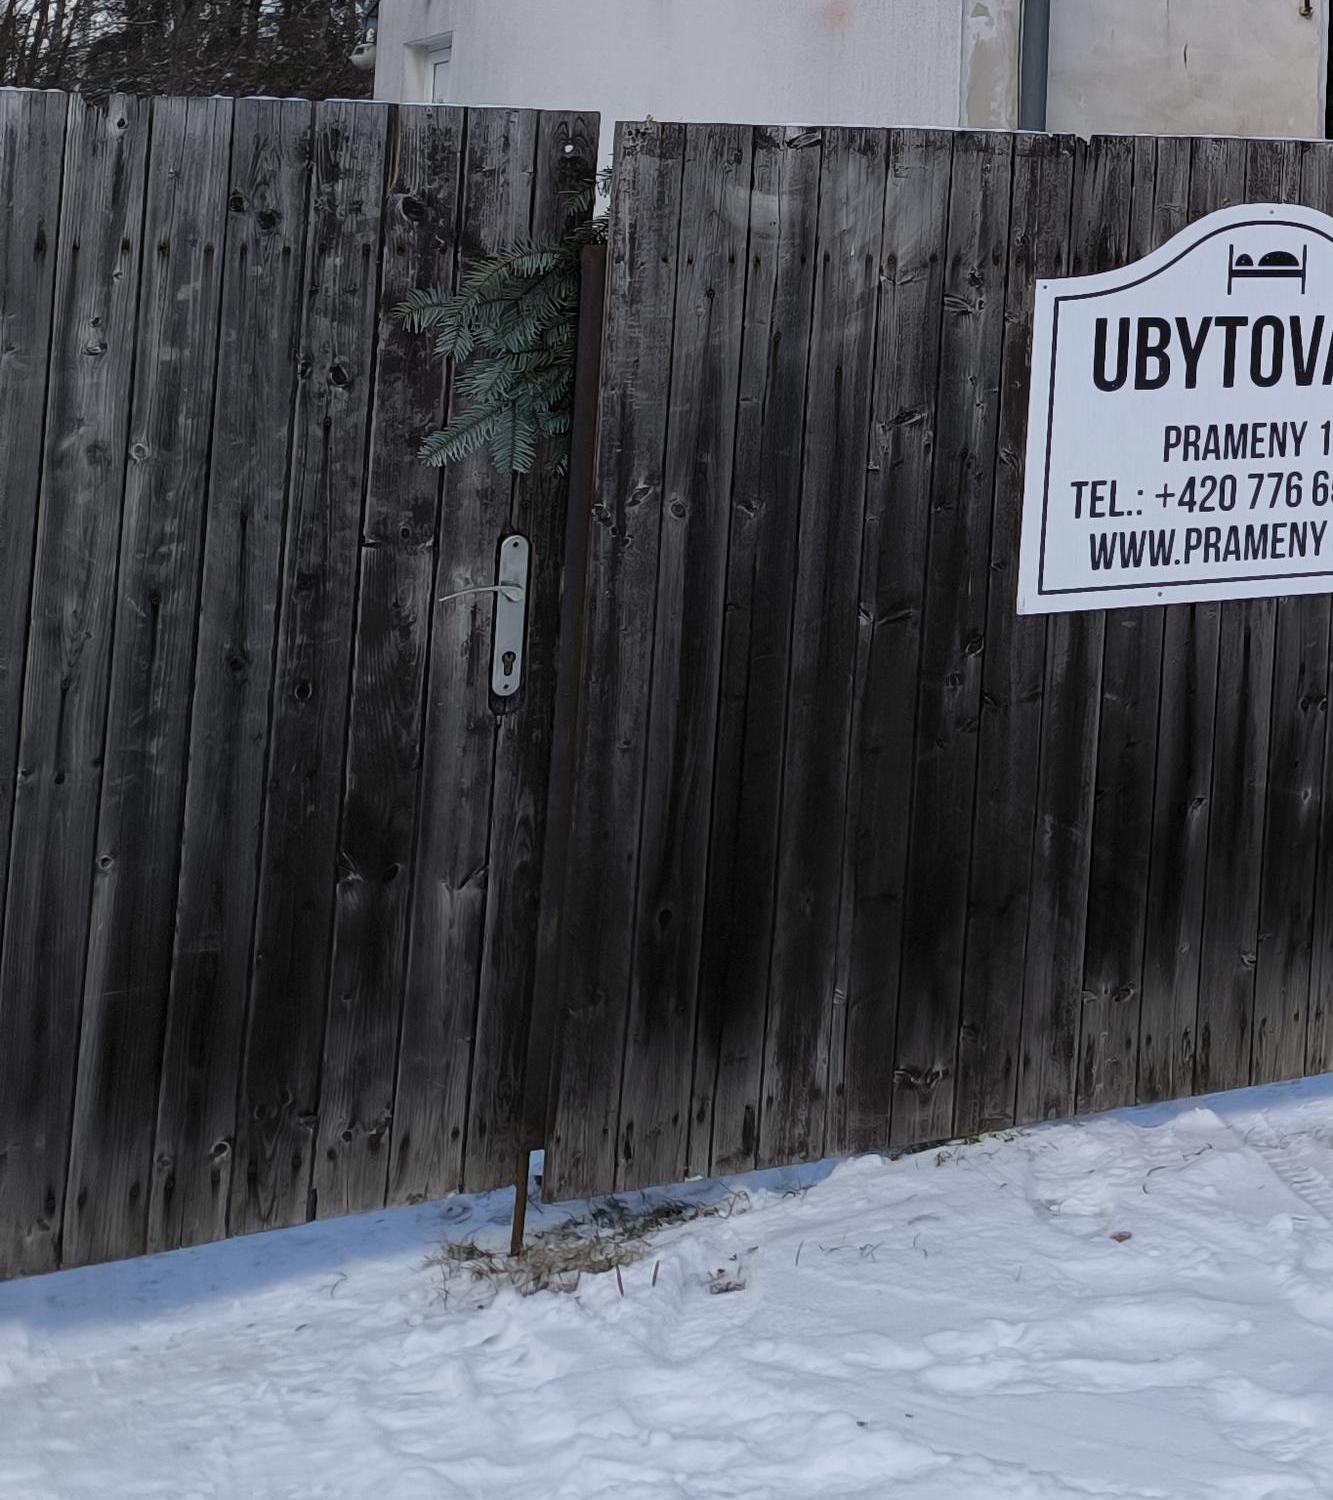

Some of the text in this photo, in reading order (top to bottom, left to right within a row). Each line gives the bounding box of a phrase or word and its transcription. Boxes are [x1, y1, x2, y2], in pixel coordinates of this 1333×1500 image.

[1164, 421, 1307, 462] PRAMENY
[1071, 480, 1143, 518] TEL.:
[1156, 475, 1236, 512] +420
[1248, 472, 1302, 509] 776
